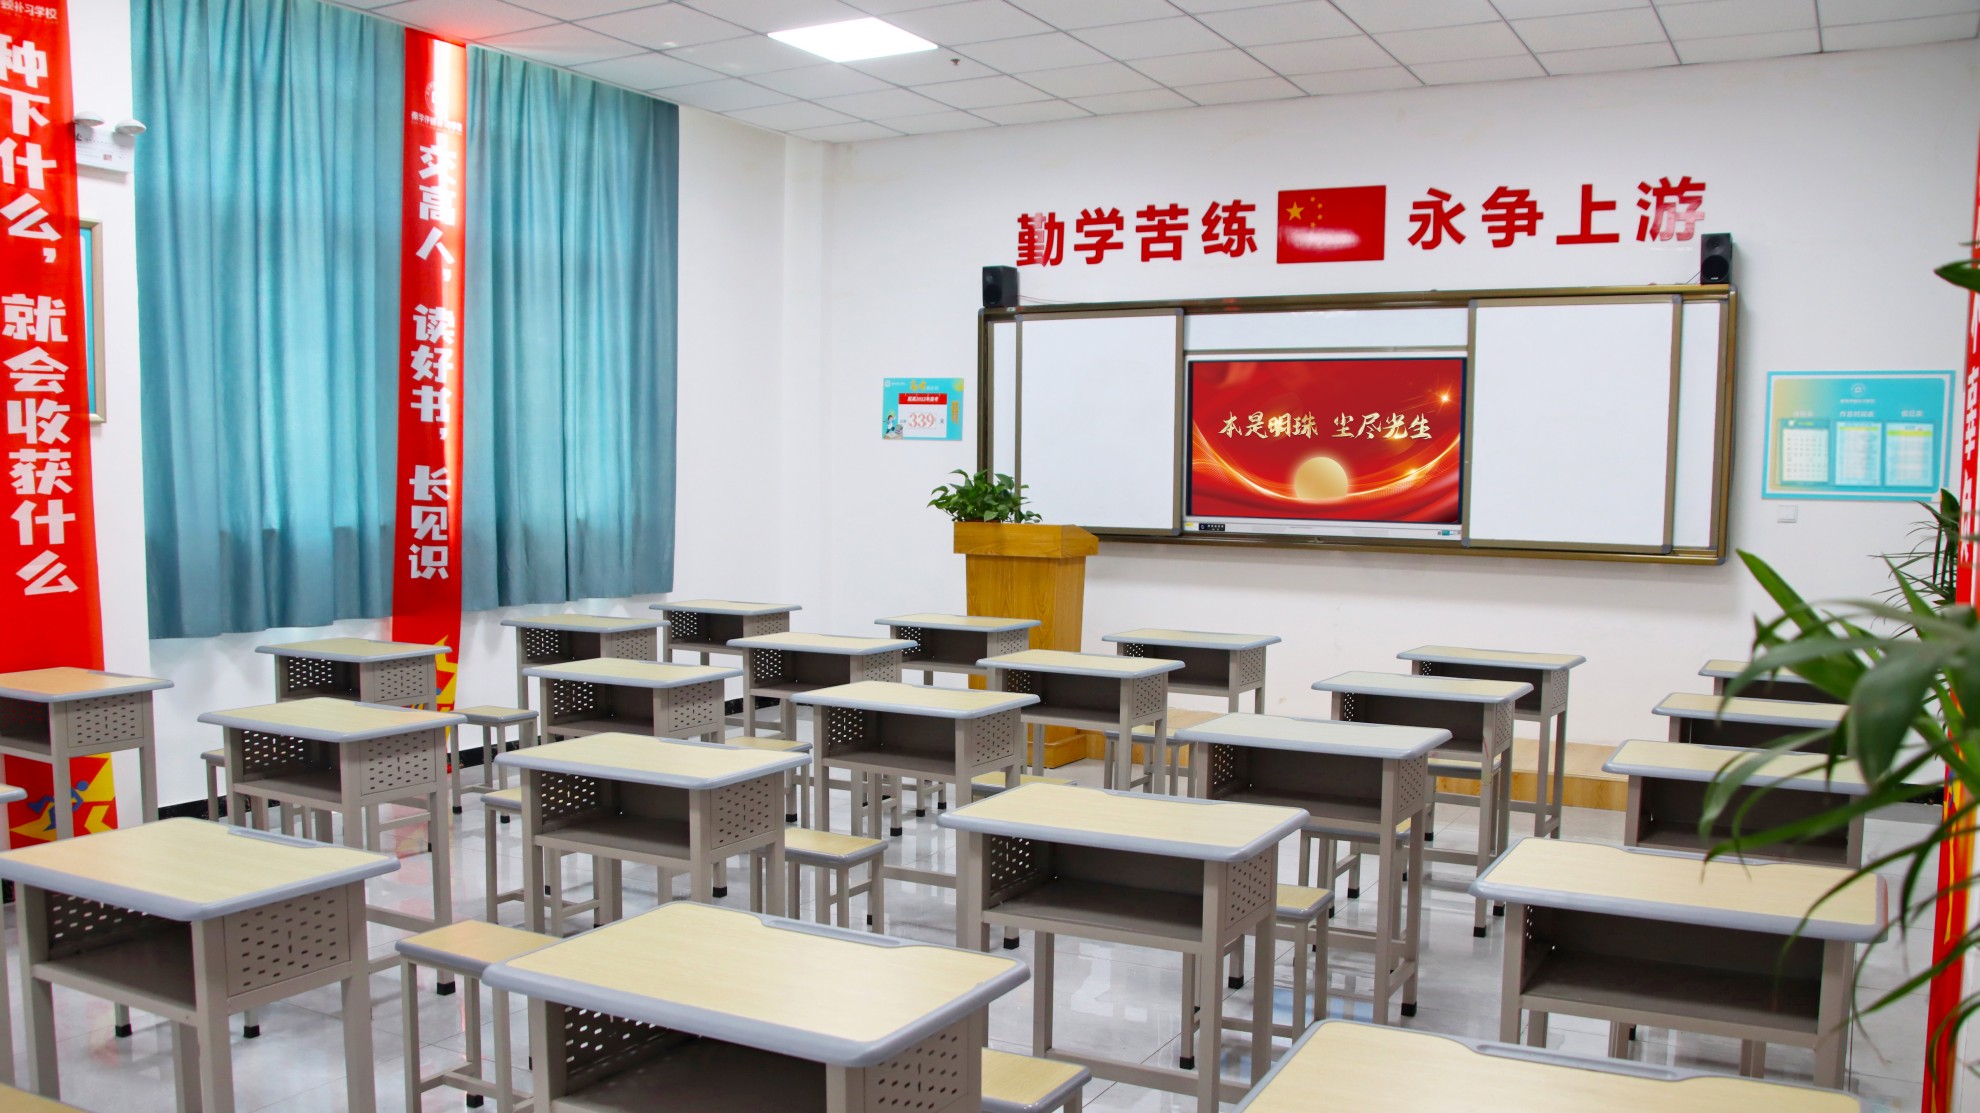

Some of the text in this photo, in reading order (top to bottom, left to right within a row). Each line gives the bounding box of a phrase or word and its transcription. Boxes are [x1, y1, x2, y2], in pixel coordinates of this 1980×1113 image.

[1016, 176, 1706, 267] 勤学苦练 永争上游
[1, 293, 79, 596] 就会收获什么
[908, 412, 936, 429] 339
[1218, 411, 1432, 440] 本是明珠 尘尽光生
[408, 464, 452, 580] 长见识
